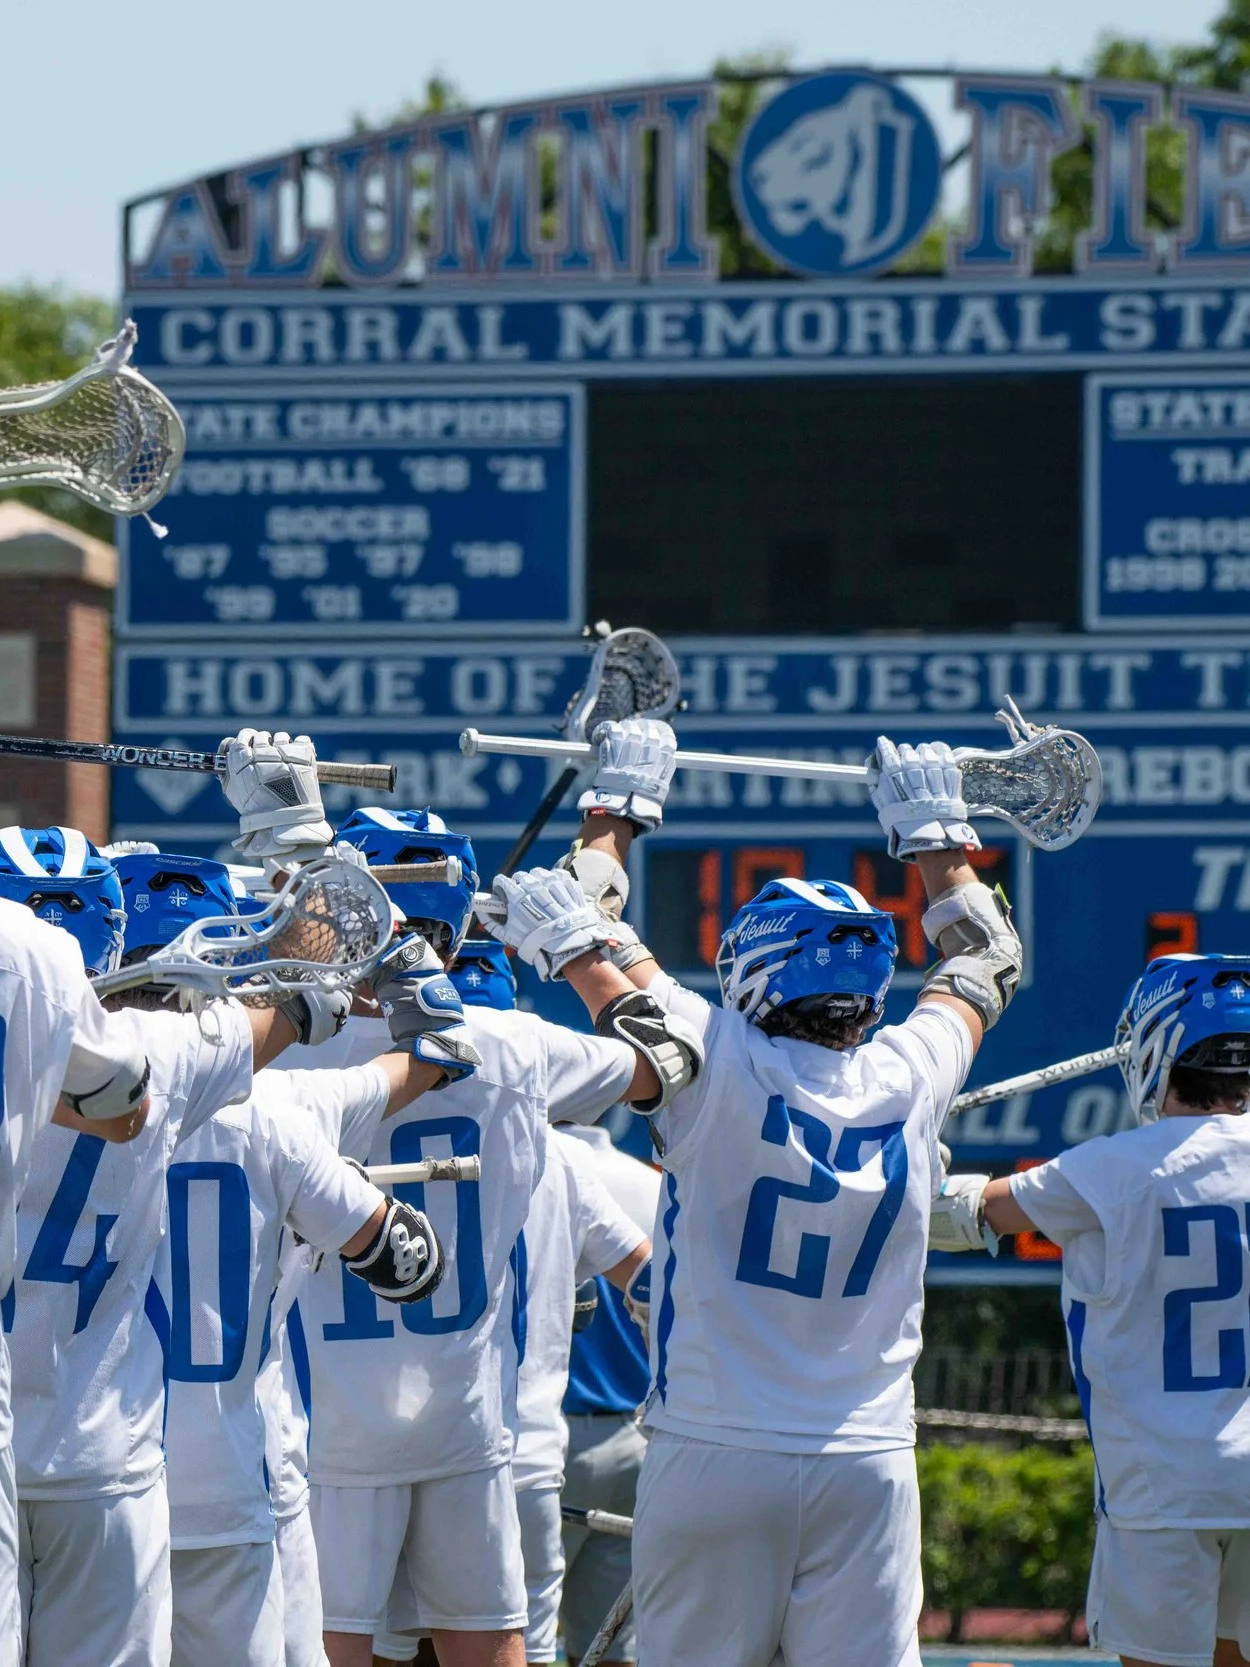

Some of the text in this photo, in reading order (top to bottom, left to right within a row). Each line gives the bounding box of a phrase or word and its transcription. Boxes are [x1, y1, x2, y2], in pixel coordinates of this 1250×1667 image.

[129, 75, 1250, 288] ALUMNI FIE
[161, 306, 529, 365] CORRAL
[558, 296, 1069, 361] MEMORIAL
[183, 400, 564, 439] ATE CHAMPIONS
[167, 456, 384, 495] FOOTBALL
[266, 505, 430, 542] SOCCER
[163, 652, 1250, 716] HOME OF HE JESUIT T
[322, 750, 490, 810] ARK
[740, 912, 797, 945] Jesuit
[1134, 970, 1177, 1021] Jesuit
[735, 1094, 908, 1299] 27
[1, 1131, 121, 1335] 4
[1163, 1205, 1250, 1393] 2
